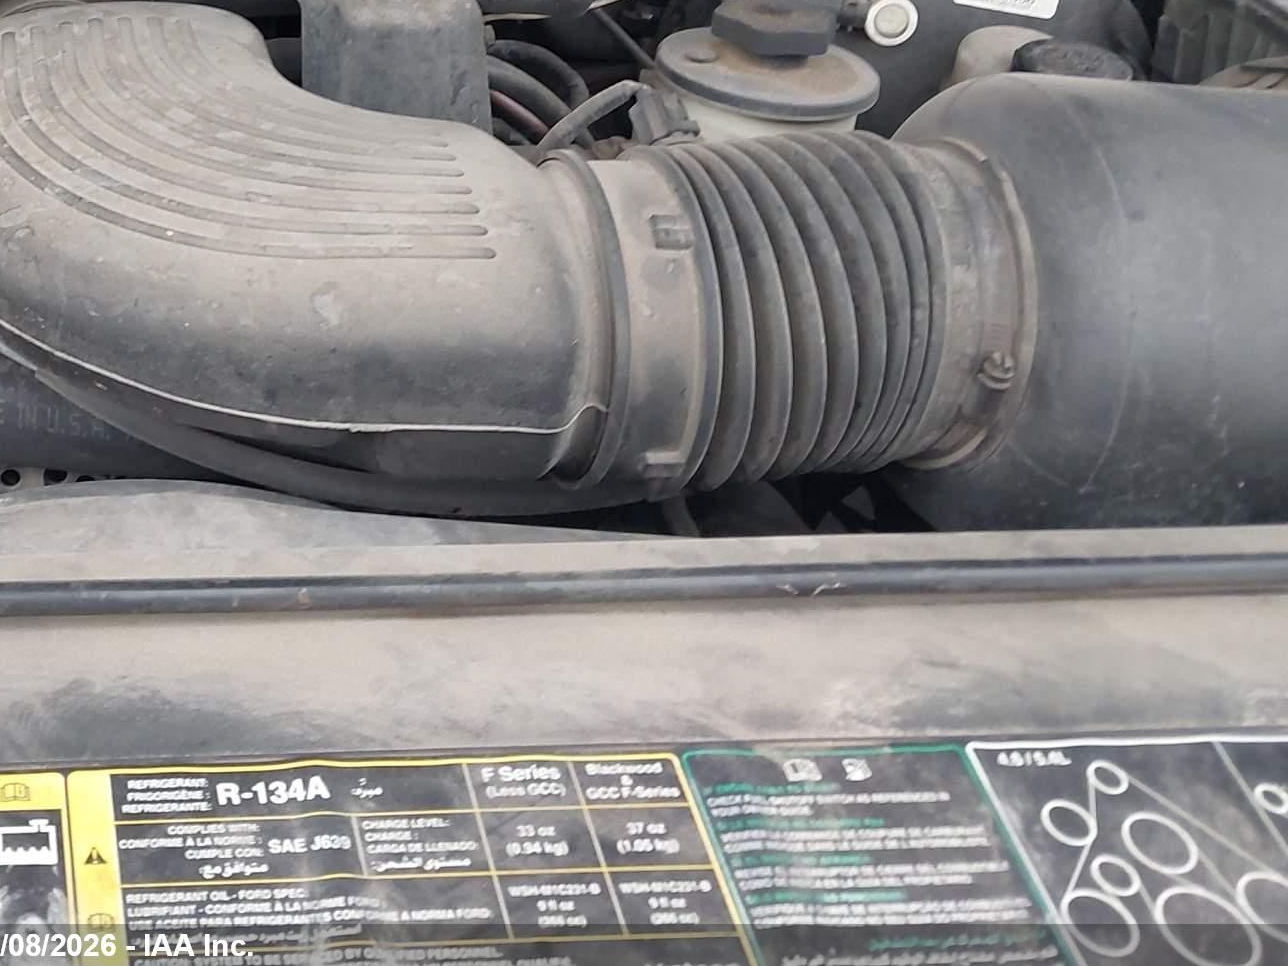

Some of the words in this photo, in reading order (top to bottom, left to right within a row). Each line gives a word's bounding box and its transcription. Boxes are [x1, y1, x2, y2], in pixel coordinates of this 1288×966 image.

[481, 767, 494, 782] F
[498, 764, 561, 782] Series
[127, 778, 208, 790] REFRIGERANT:
[216, 775, 330, 806] R-134A
[167, 824, 225, 835] COMPLIES
[362, 818, 409, 830] CHARGE
[119, 837, 183, 849] CONFORME
[199, 836, 212, 846] LA
[365, 831, 412, 842] CHARGE
[267, 838, 308, 855] SAE
[311, 834, 352, 851] J639
[366, 843, 407, 854] CARGA
[408, 842, 423, 852] DE
[185, 849, 233, 860] CUMPLE
[126, 891, 208, 904] REFRIGERANT
[210, 891, 230, 901] OIL
[239, 889, 271, 900] FORD
[127, 905, 196, 917] LUBRIFIANT
[205, 903, 272, 915] CONFORME
[286, 901, 301, 912] LA
[129, 920, 153, 931] USE
[155, 918, 198, 929] ACEITE
[199, 916, 232, 927] PARA
